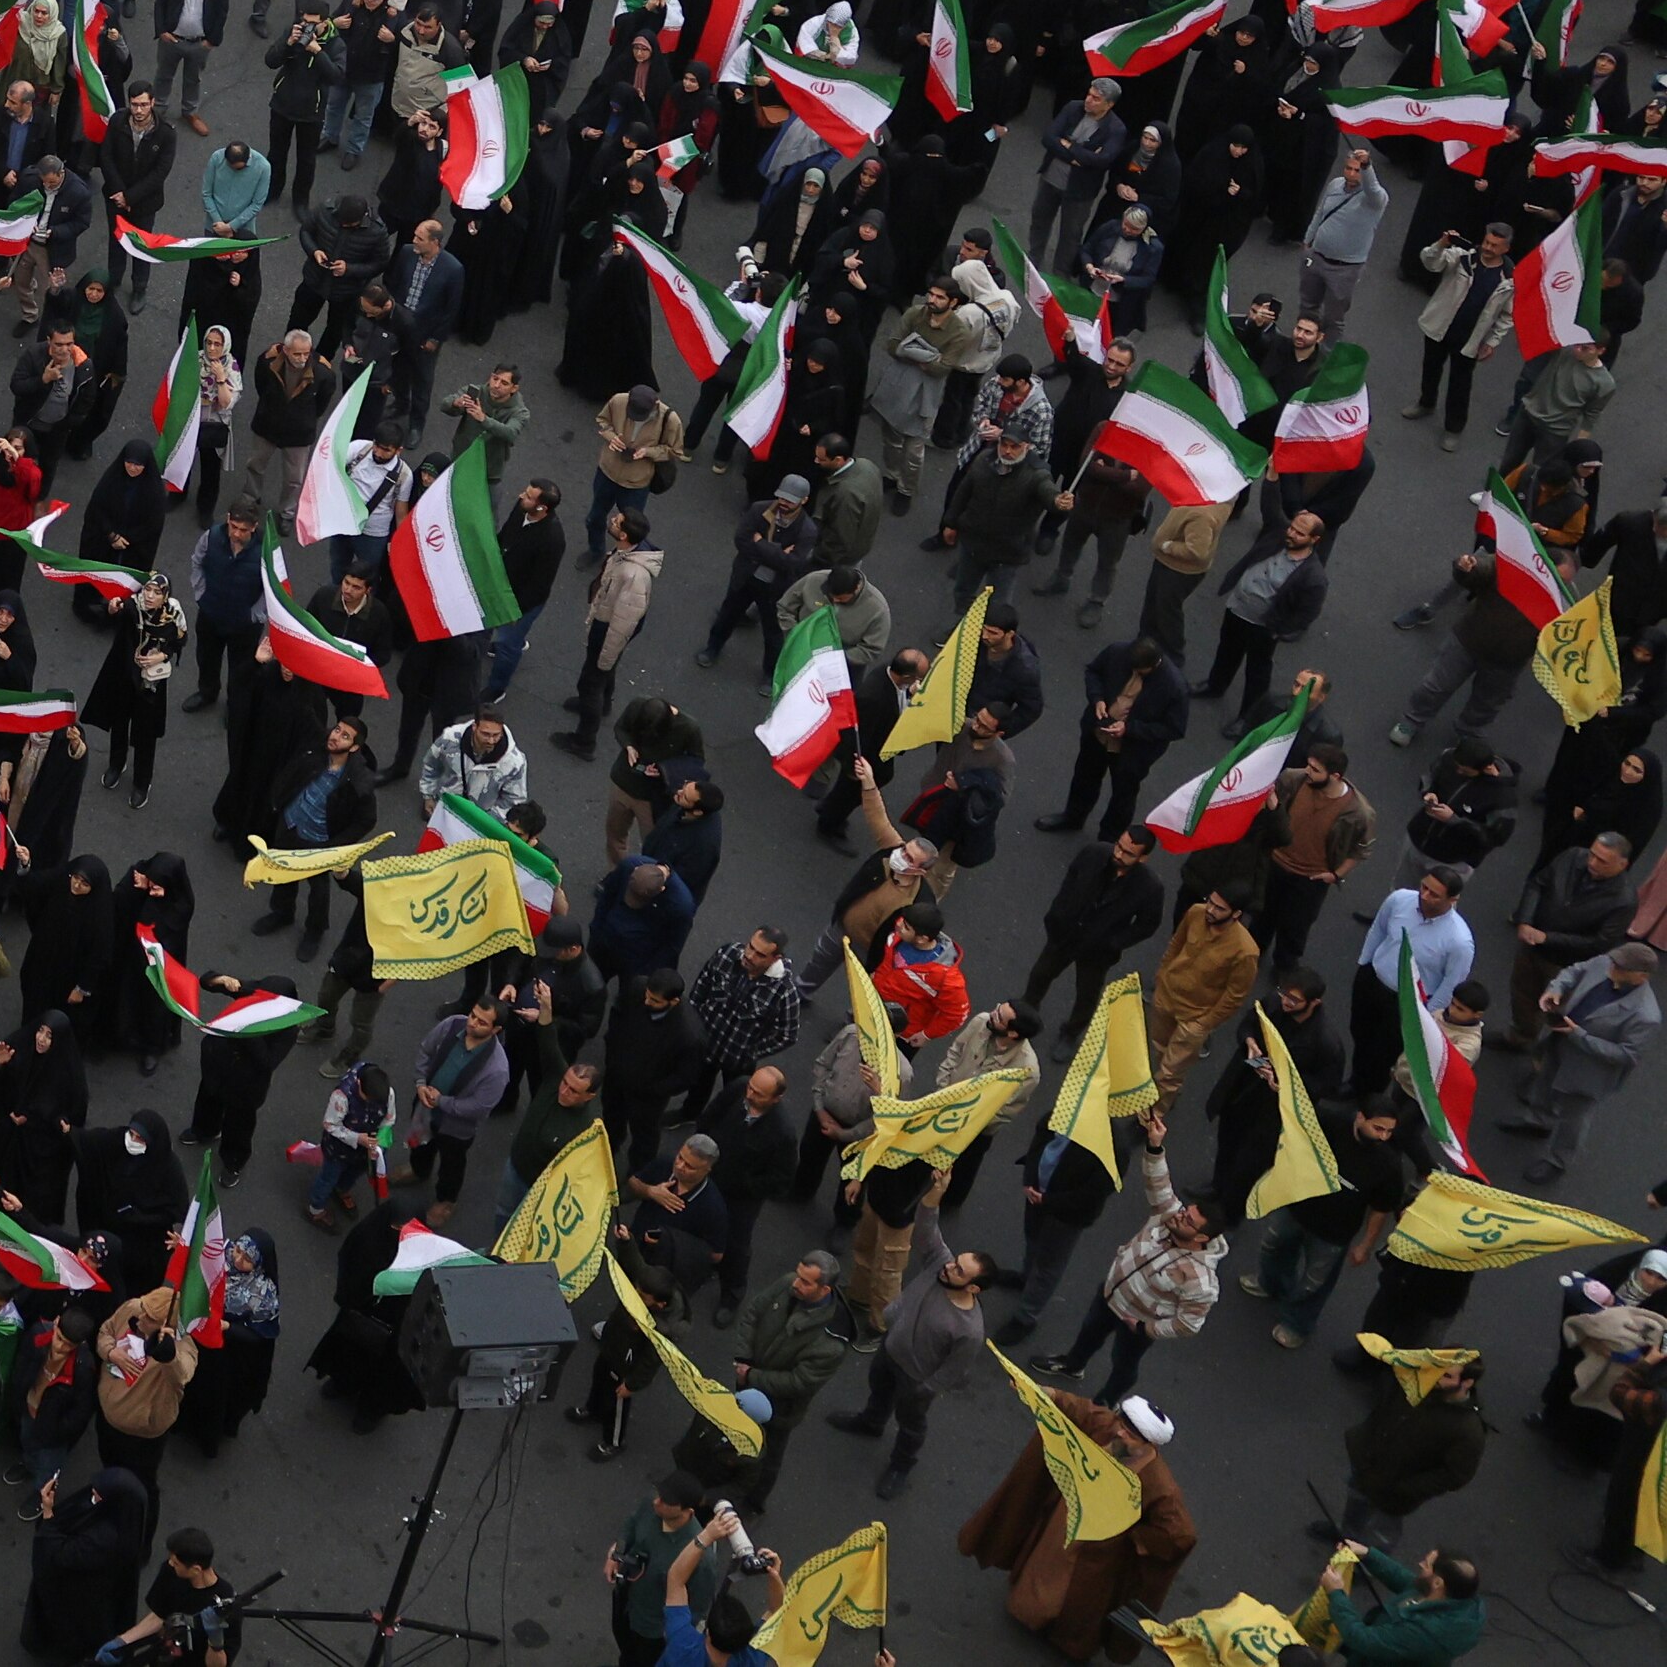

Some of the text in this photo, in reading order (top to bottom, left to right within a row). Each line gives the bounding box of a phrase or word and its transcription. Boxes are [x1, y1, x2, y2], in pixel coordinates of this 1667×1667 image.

[409, 868, 489, 940] لشکر قدس
[548, 1172, 585, 1260] لشکر
